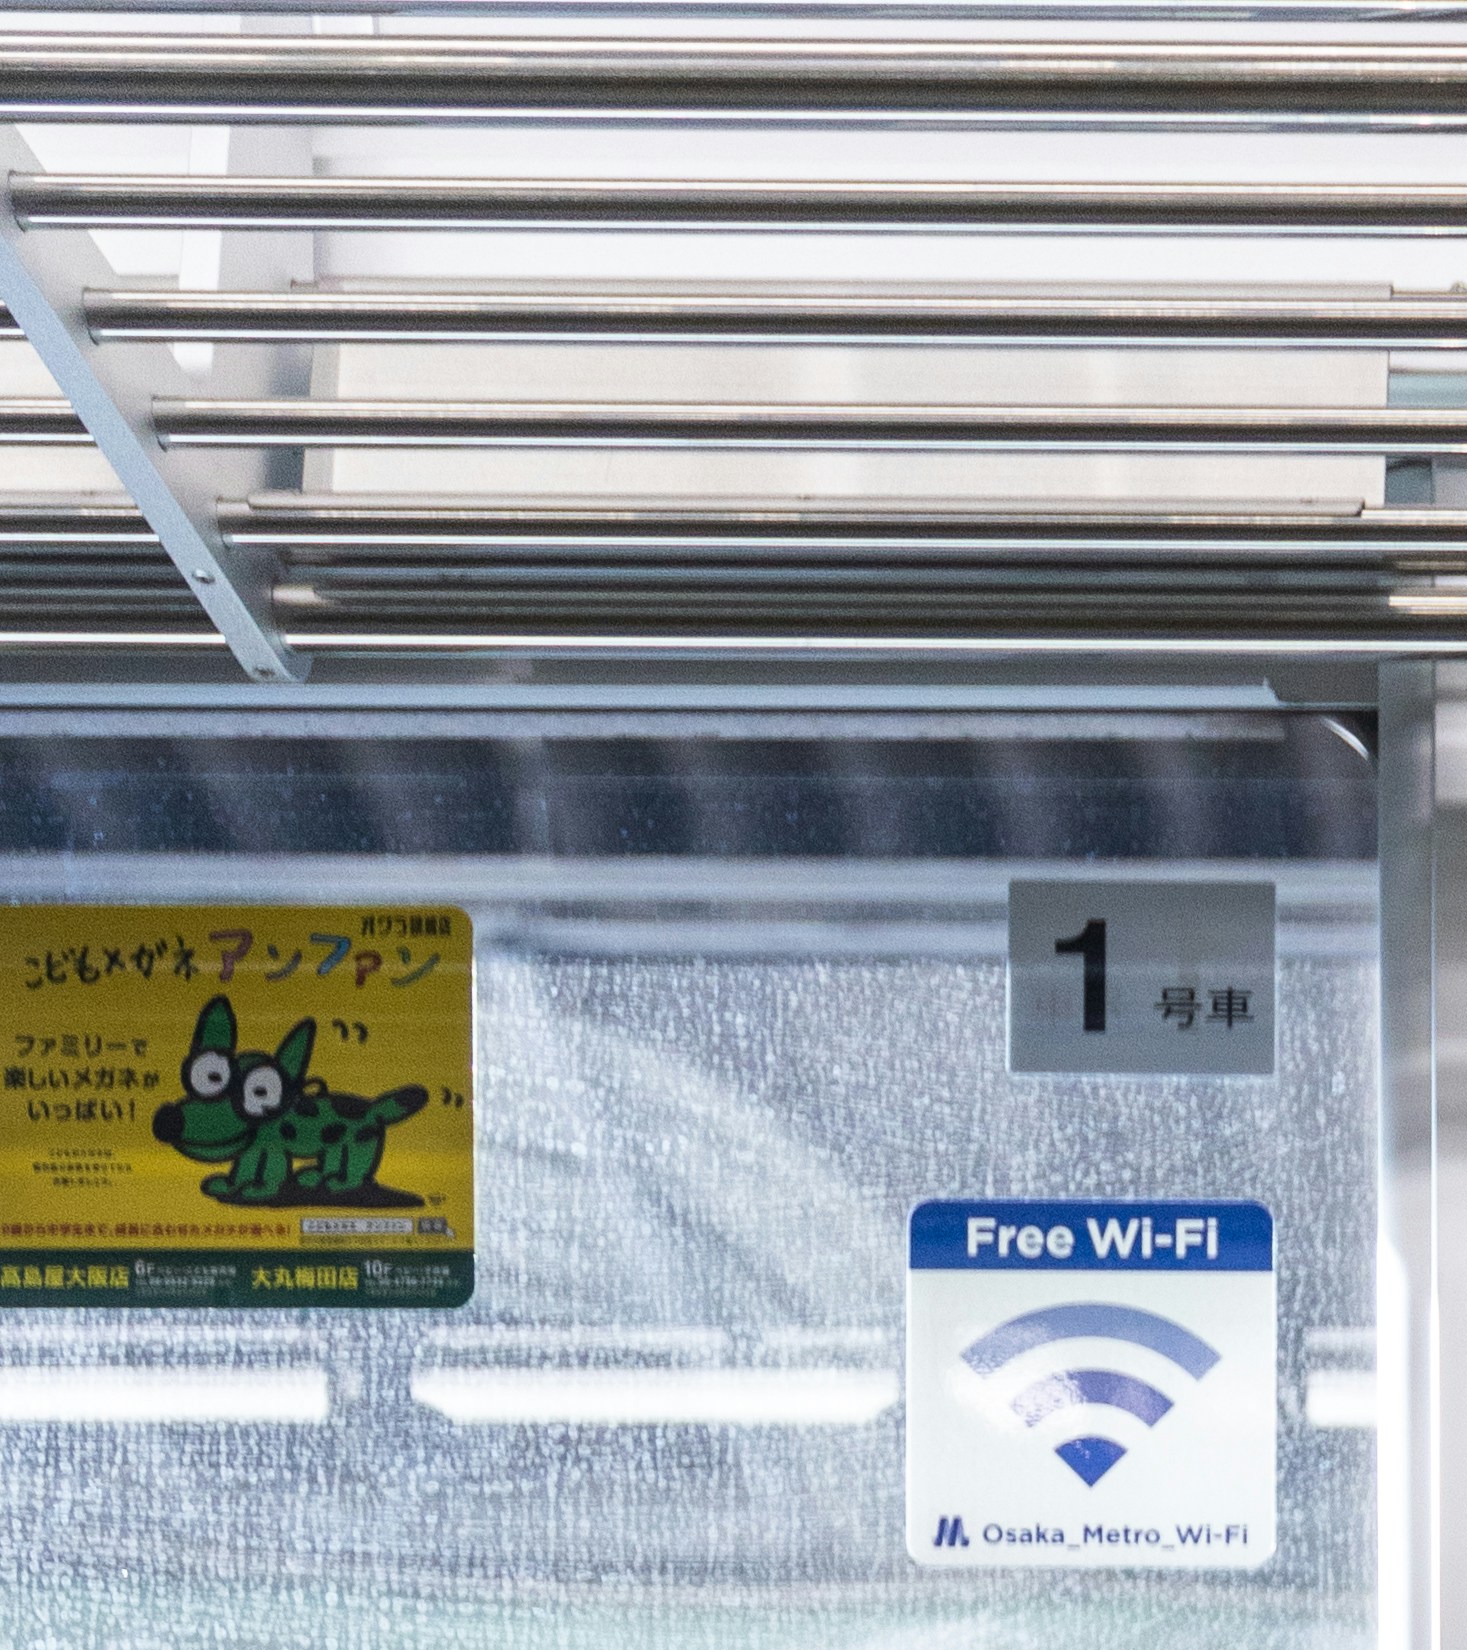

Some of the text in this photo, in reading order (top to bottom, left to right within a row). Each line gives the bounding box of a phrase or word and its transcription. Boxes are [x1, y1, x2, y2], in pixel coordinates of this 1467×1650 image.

[1055, 918, 1255, 1033] 1 号車
[966, 1216, 1219, 1260] Free Wi-Fi
[982, 1522, 1249, 1551] Osaka_Metro_Wi-Fi
